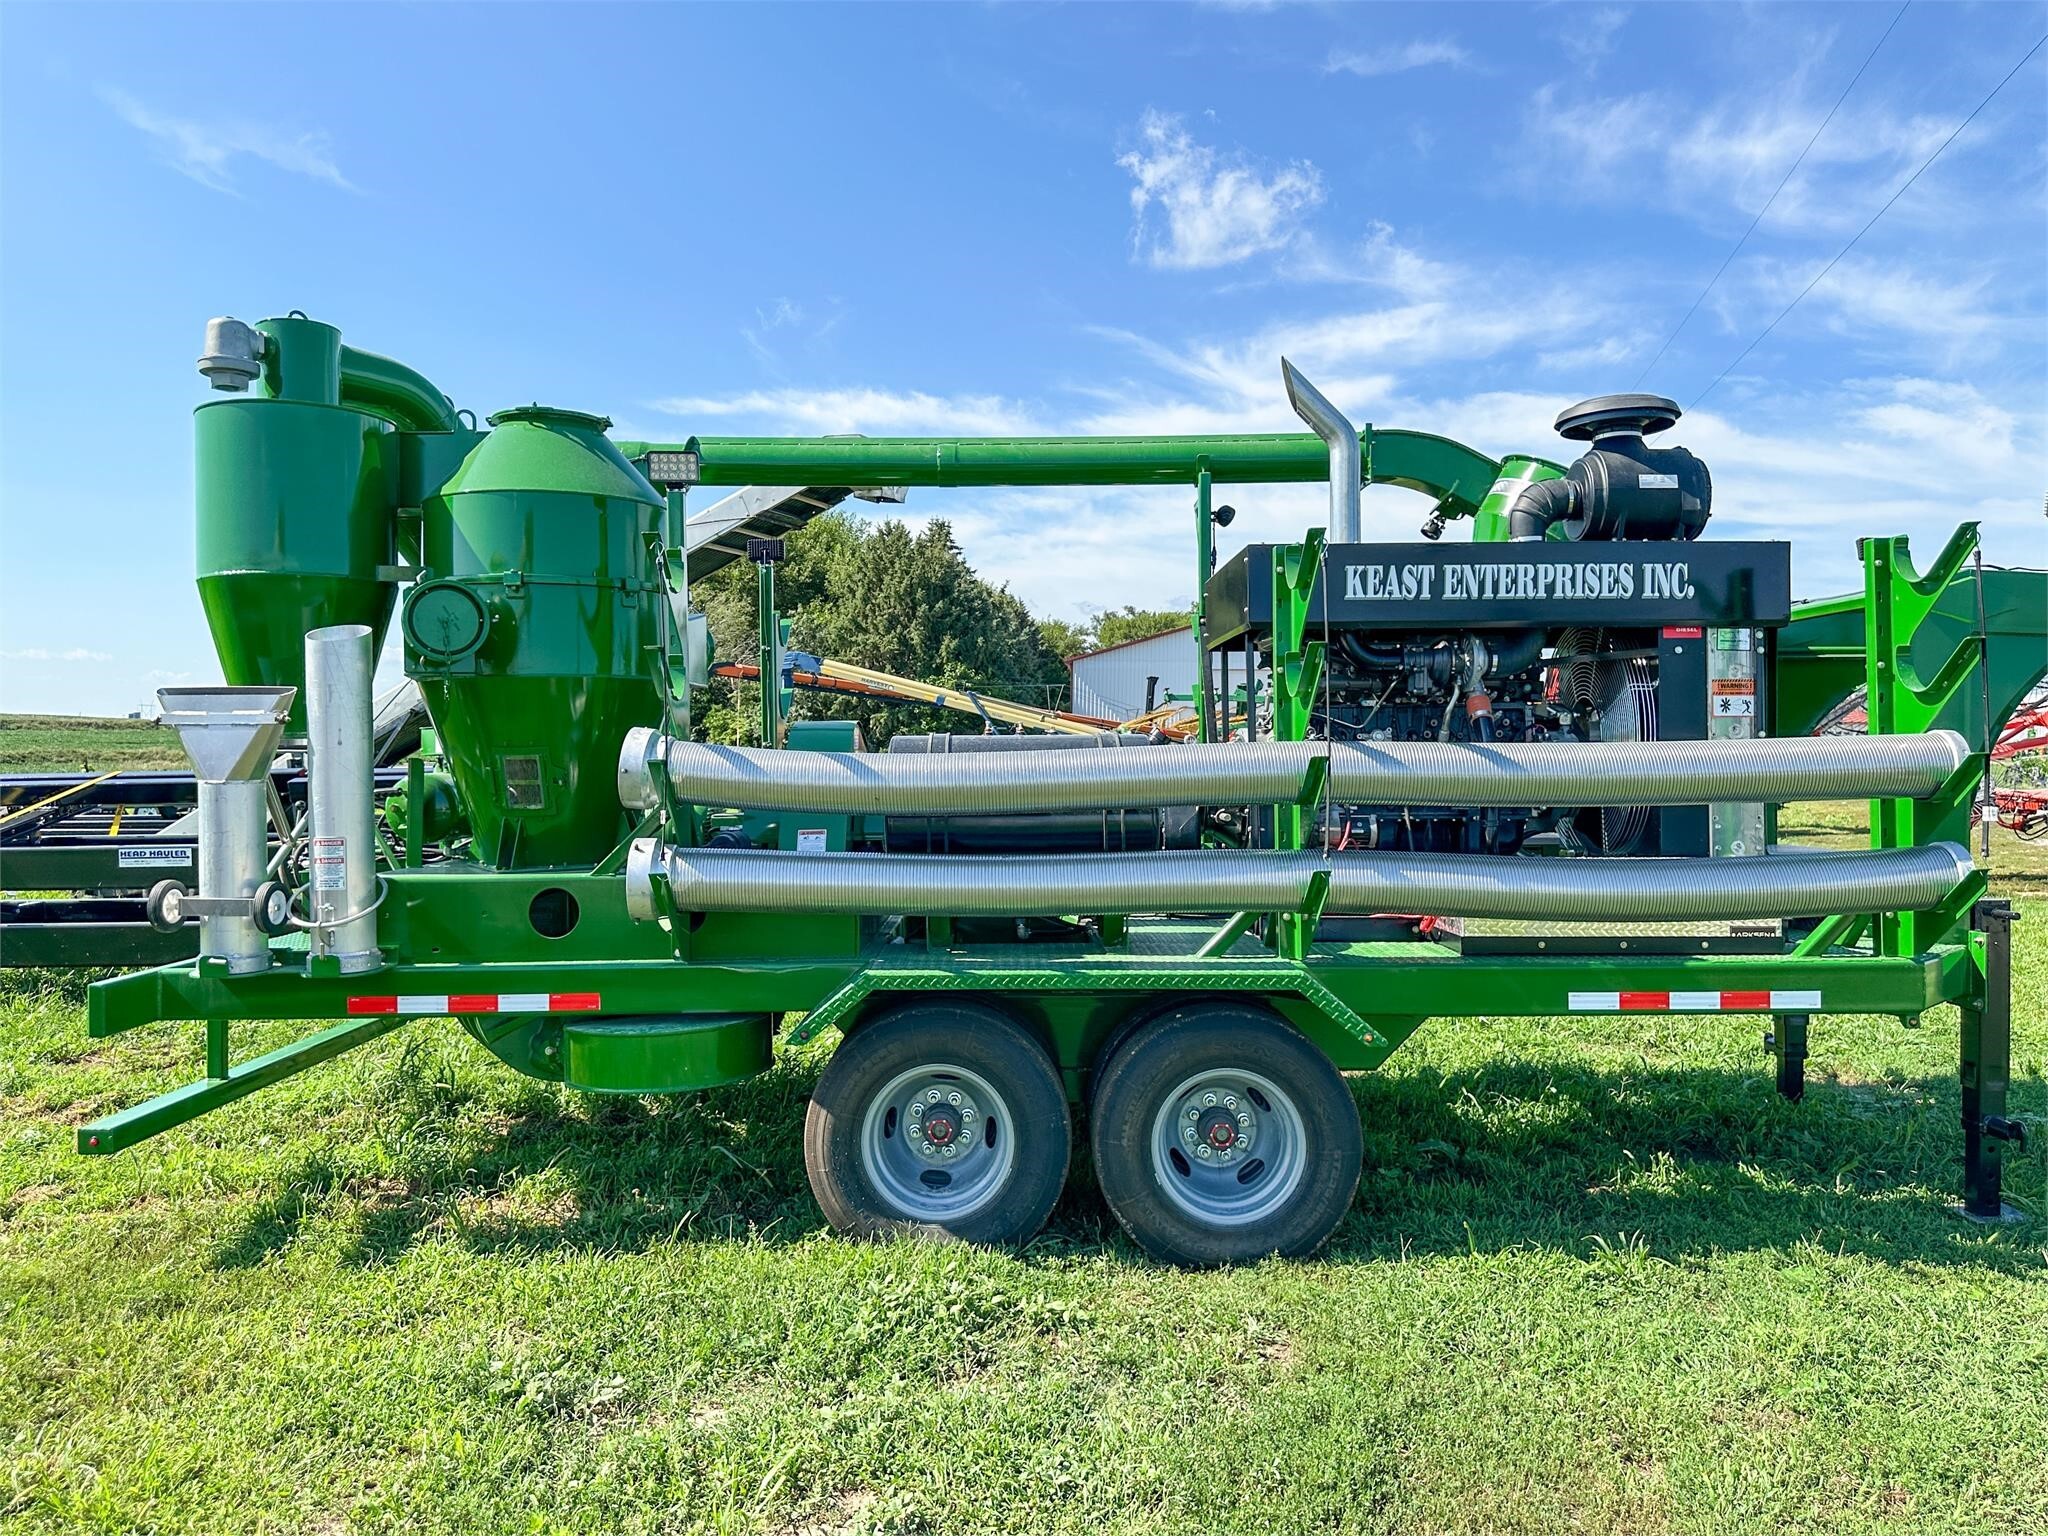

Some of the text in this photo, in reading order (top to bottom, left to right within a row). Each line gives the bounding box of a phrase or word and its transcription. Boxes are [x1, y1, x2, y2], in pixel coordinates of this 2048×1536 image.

[1344, 563, 1695, 600] KEAST ENTERPRISES INC.
[149, 850, 187, 858] HAULER
